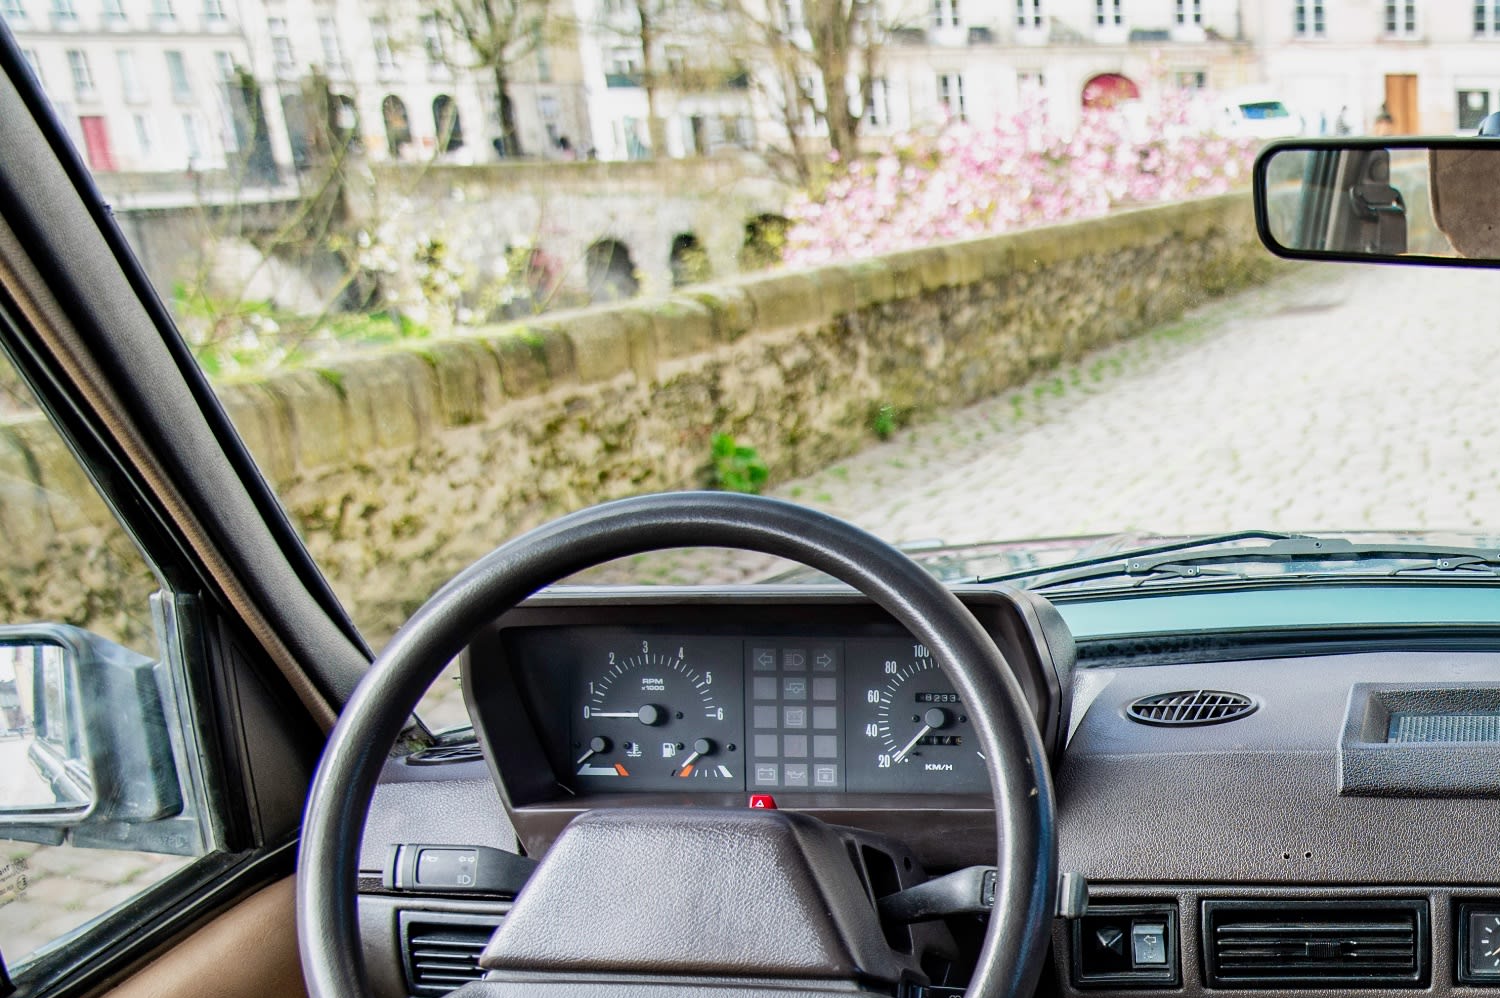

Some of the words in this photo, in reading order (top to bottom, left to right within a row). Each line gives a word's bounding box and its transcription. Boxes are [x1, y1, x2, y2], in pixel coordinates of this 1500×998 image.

[642, 641, 649, 653] 3
[678, 647, 684, 659] 4
[913, 645, 930, 658] 100
[608, 652, 615, 665] 2
[885, 661, 897, 674] 80
[705, 672, 712, 685] 5
[589, 682, 594, 694] 1
[867, 690, 880, 703] 60
[583, 706, 590, 719] 0
[716, 708, 724, 721] 6
[865, 724, 878, 737] 40
[878, 755, 891, 768] 20
